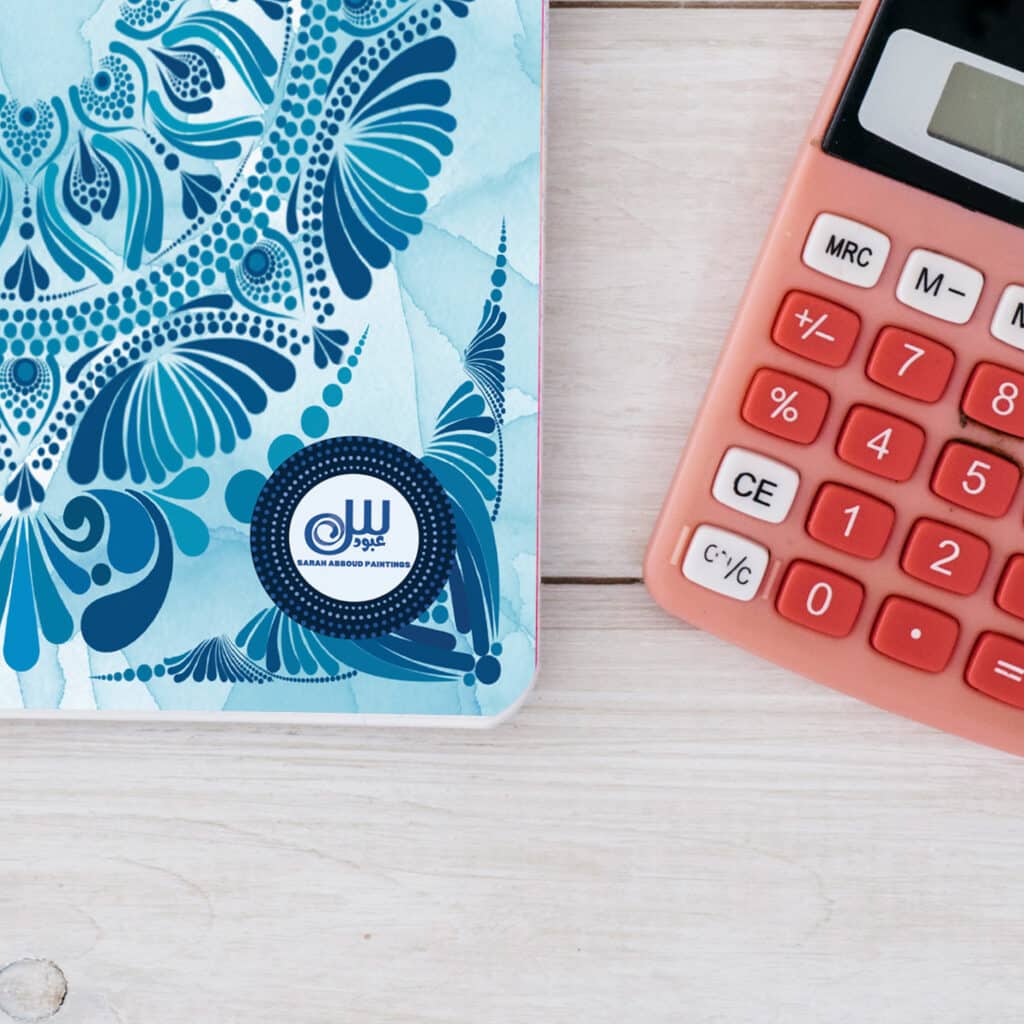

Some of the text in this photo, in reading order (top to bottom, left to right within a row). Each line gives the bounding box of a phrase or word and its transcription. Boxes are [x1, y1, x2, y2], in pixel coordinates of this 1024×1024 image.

[825, 234, 873, 268] MRC
[898, 343, 925, 376] 7
[770, 387, 799, 422] %
[991, 382, 1019, 416] 8
[866, 428, 893, 460] 4
[732, 471, 778, 508] CE
[961, 460, 991, 495] 5
[843, 505, 860, 537] 1
[297, 559, 327, 567] SARAH
[328, 560, 363, 568] ABBOUD
[930, 540, 961, 576] 2
[806, 582, 833, 616] 0
